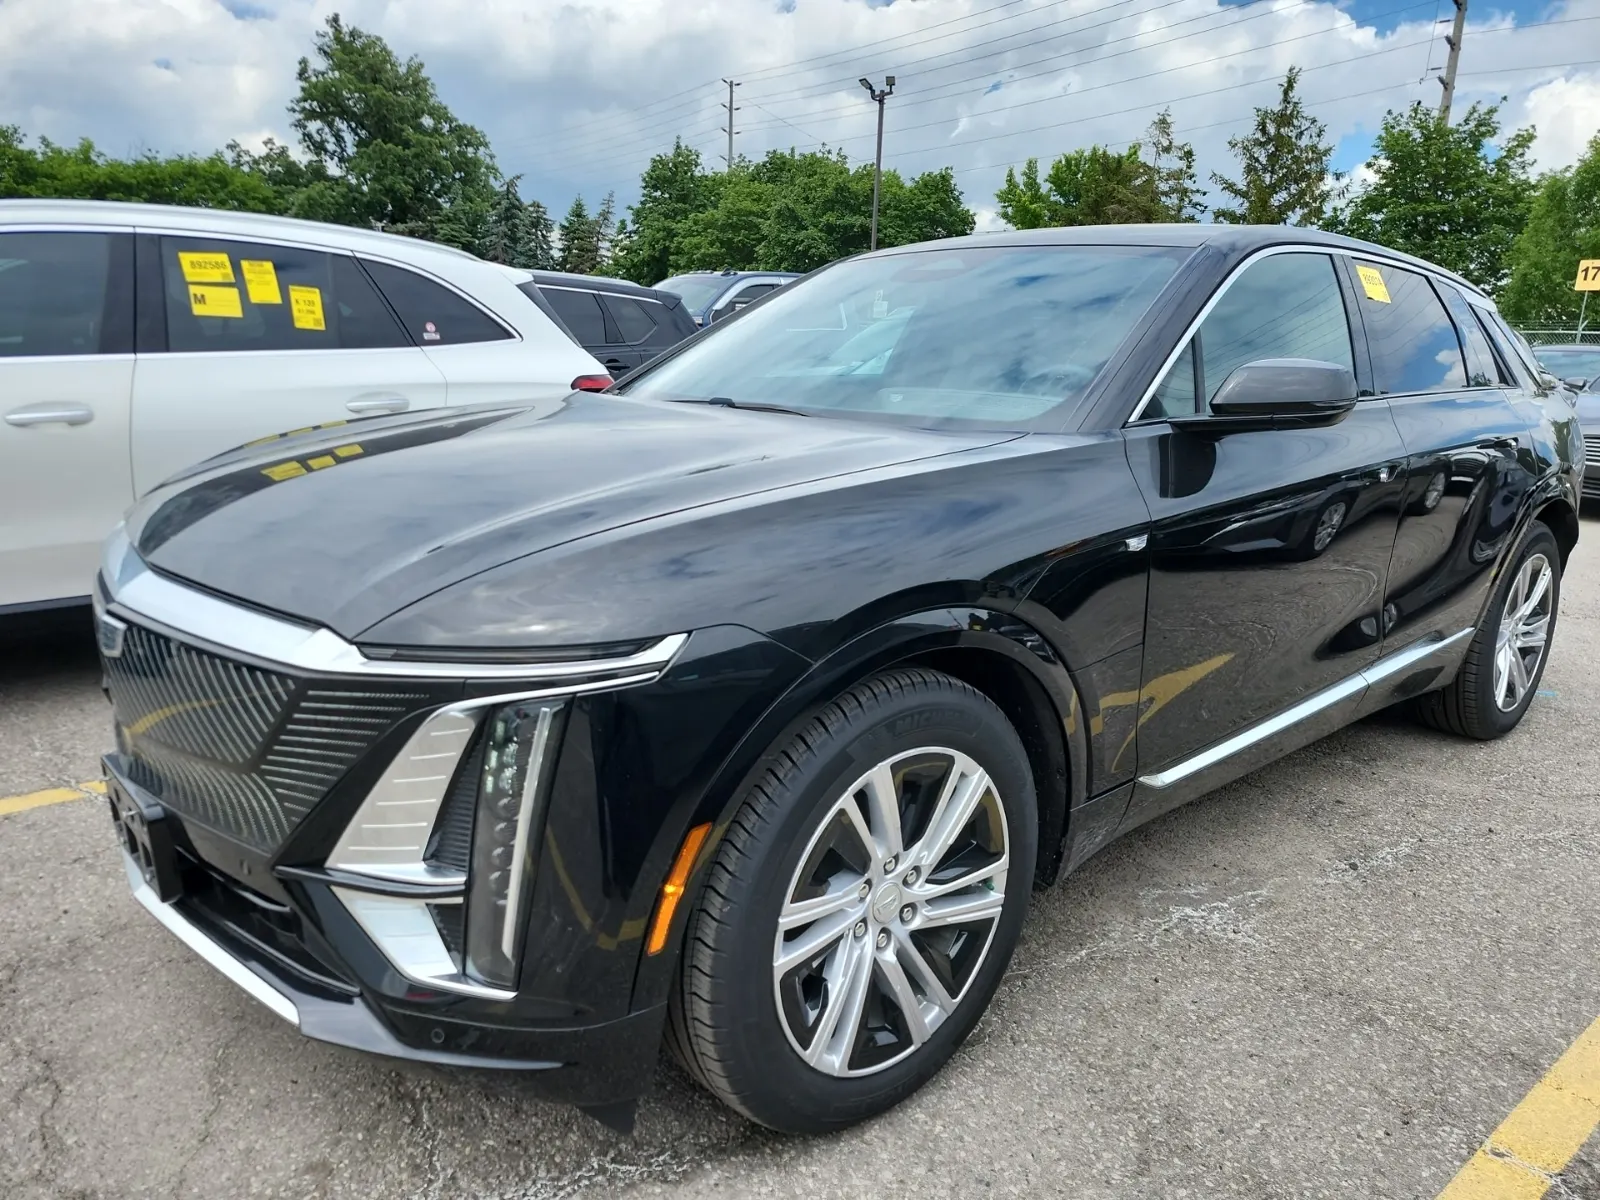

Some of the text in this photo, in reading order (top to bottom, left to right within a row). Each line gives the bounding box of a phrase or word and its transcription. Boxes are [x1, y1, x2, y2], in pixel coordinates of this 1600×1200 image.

[1581, 266, 1600, 281] 17
[193, 293, 207, 305] M
[896, 710, 980, 734] MICHE
